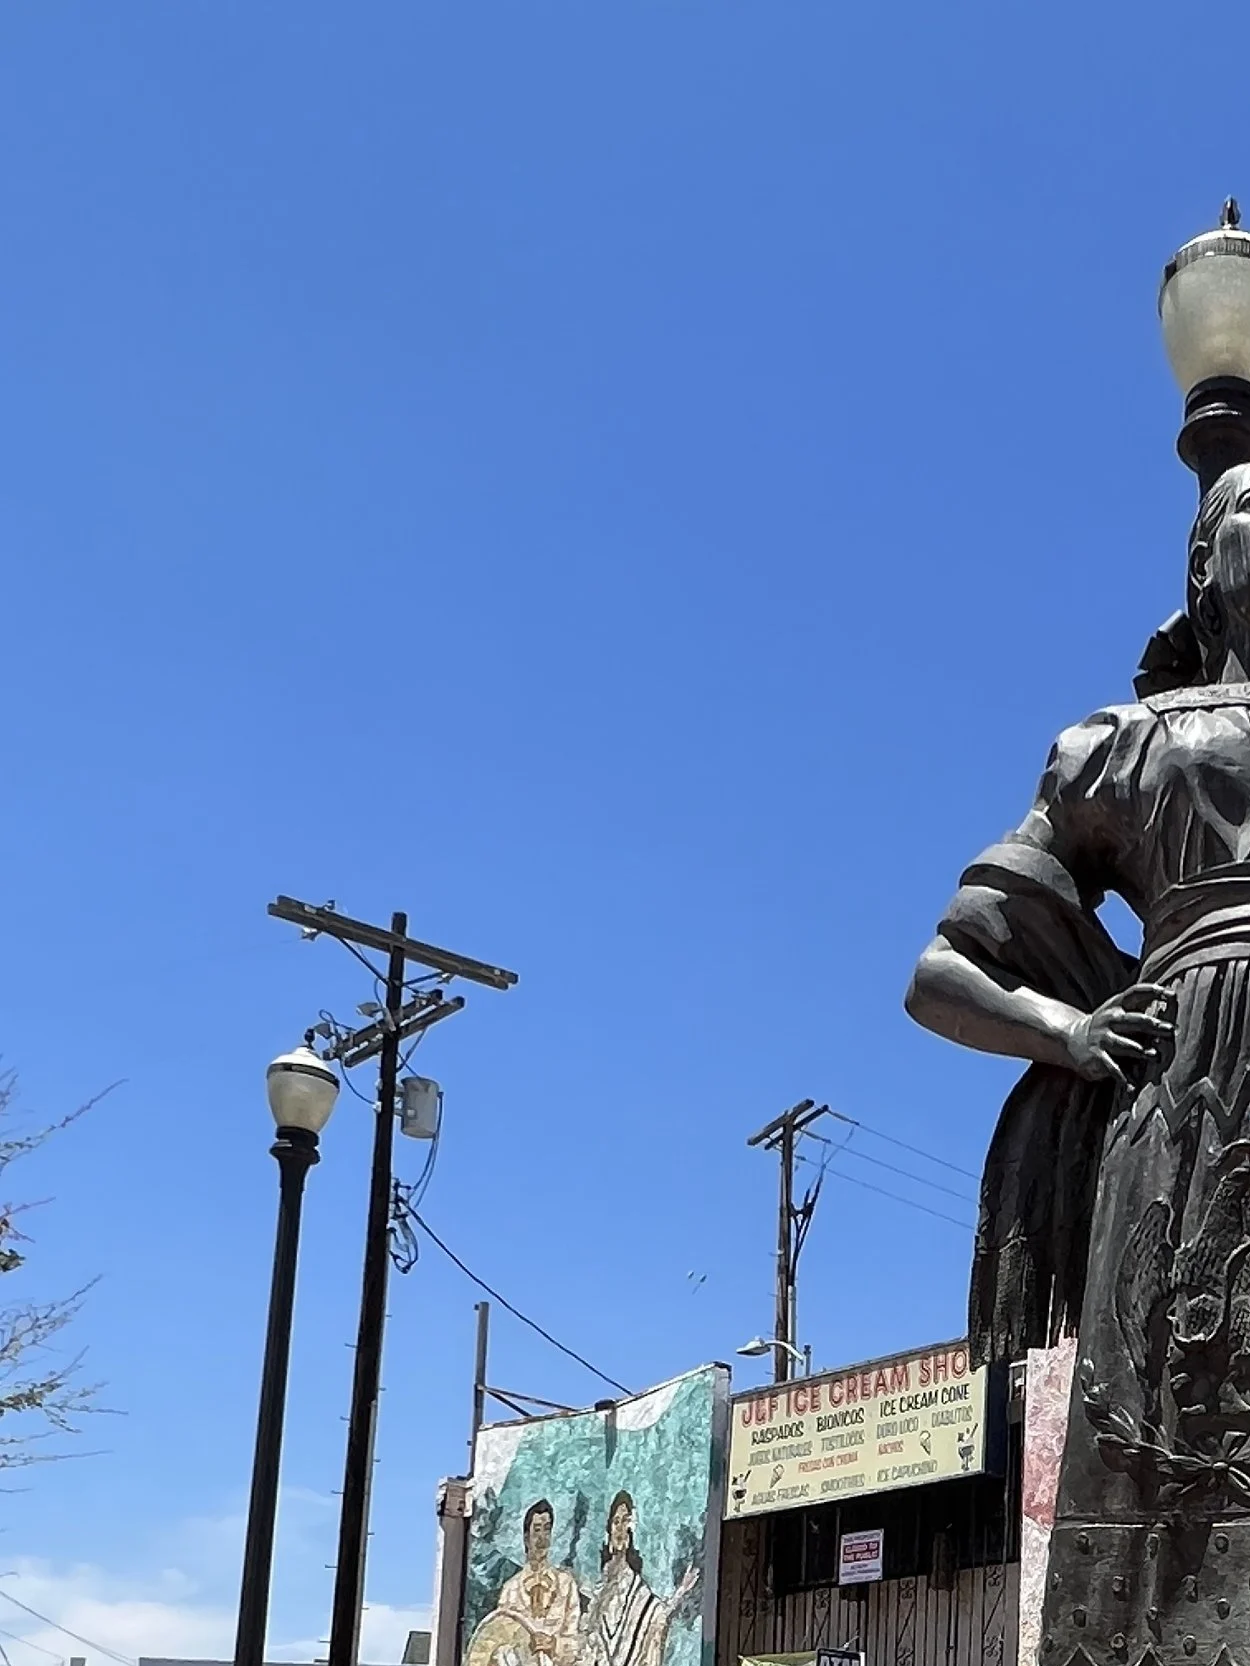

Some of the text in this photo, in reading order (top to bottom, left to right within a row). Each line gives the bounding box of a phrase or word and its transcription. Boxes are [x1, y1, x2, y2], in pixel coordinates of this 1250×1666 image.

[751, 1383, 970, 1446] RASPADOS BIONICOS ICE CREAM CONE
[786, 1384, 821, 1418] ICE
[829, 1362, 911, 1408] CREAM
[920, 1345, 970, 1388] SHO
